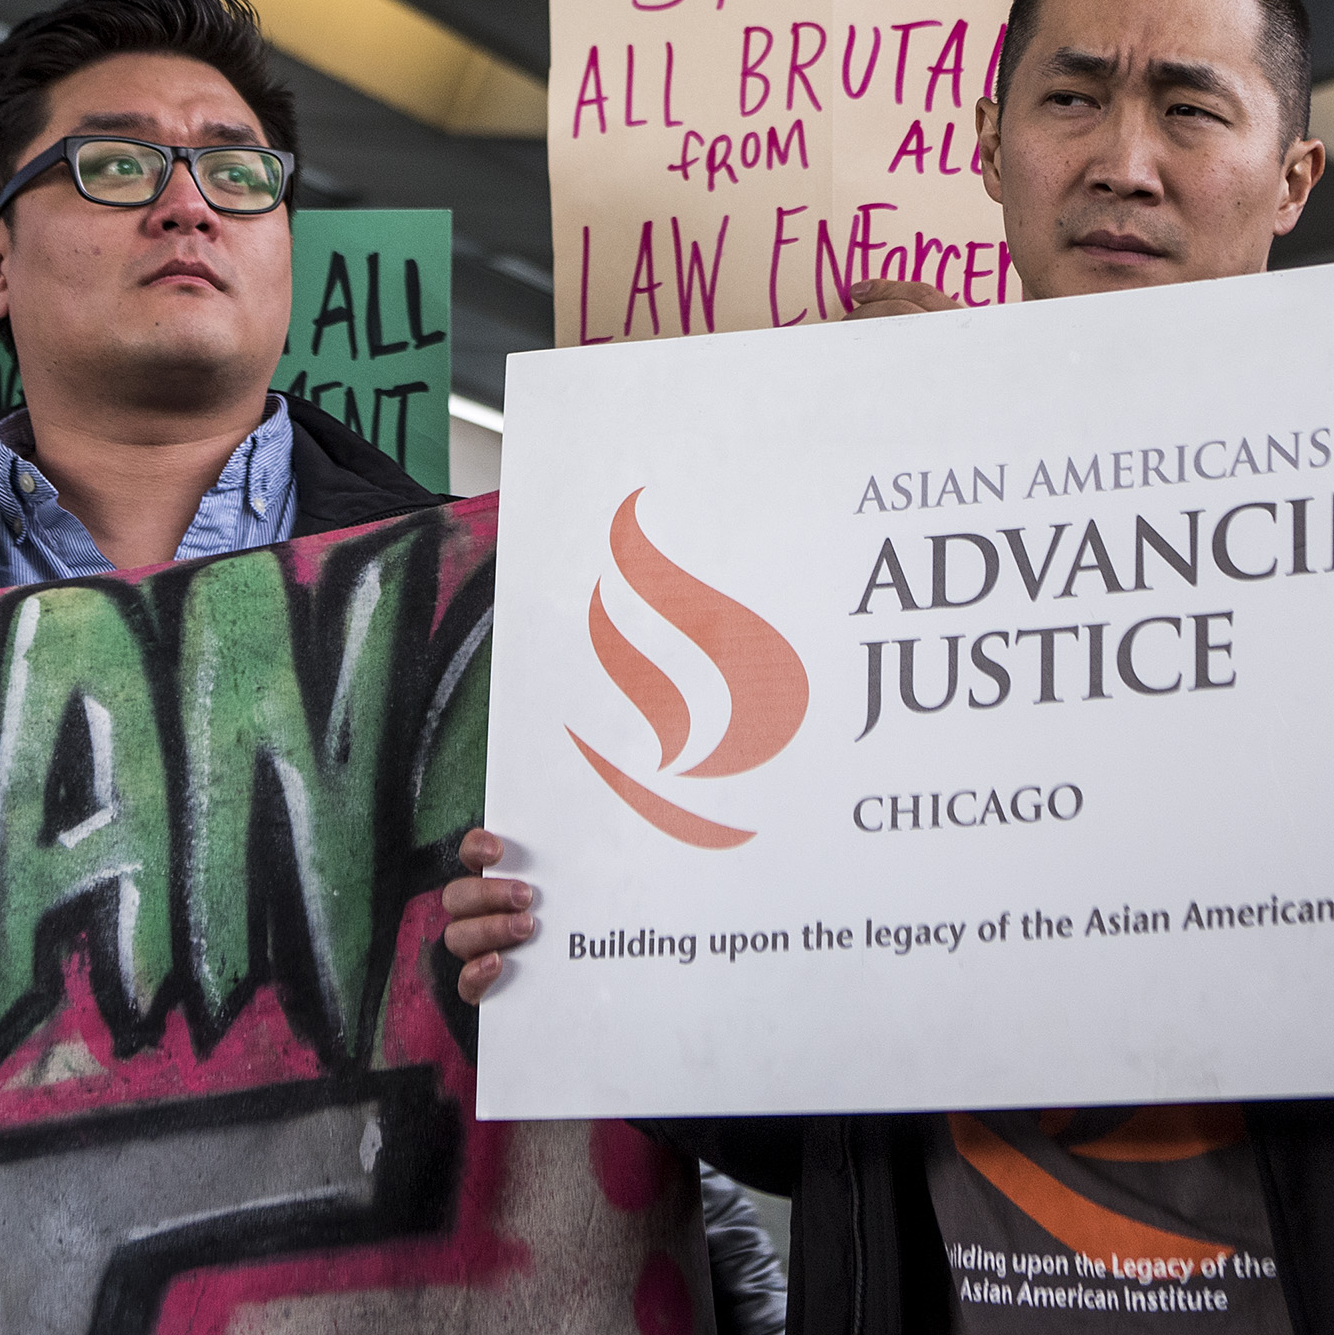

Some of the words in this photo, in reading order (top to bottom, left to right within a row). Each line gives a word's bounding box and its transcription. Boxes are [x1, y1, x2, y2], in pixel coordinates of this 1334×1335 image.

[572, 43, 683, 139] ALL
[311, 250, 447, 361] ALL
[579, 214, 730, 346] LAW
[857, 464, 1006, 515] ASIAN
[1025, 427, 1333, 503] AMERICANS
[855, 611, 1237, 743] JUSTICE
[853, 783, 1084, 833] CHICAGO
[568, 928, 697, 964] Building
[709, 930, 789, 963] upon
[801, 921, 854, 951] the
[865, 918, 966, 955] legacy
[977, 912, 1011, 942] of
[1020, 910, 1073, 940] the
[1085, 905, 1170, 937] Asian
[960, 1275, 1013, 1305] Asian
[1017, 1279, 1120, 1312] American
[1123, 1283, 1229, 1313] Institute
[1012, 1252, 1069, 1281] upon
[1074, 1250, 1107, 1279] the
[1200, 1251, 1228, 1279] of
[1232, 1250, 1278, 1279] the
